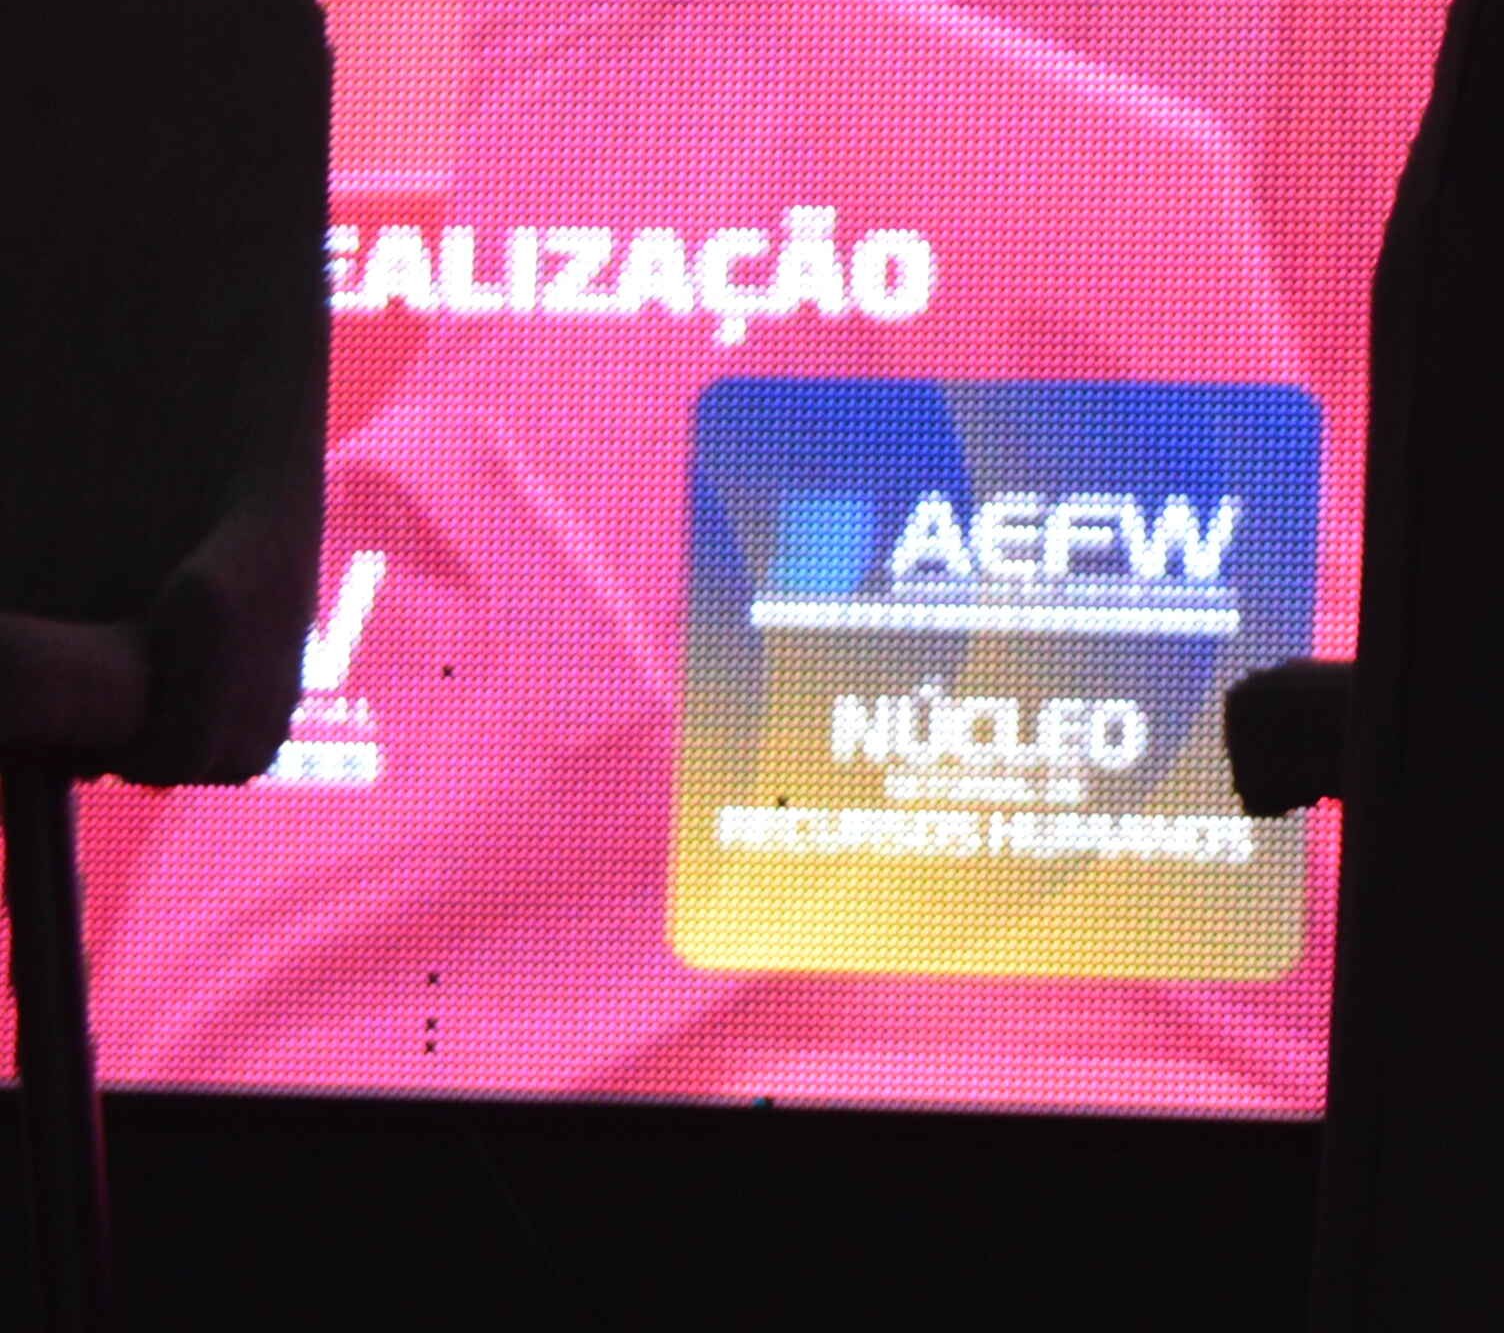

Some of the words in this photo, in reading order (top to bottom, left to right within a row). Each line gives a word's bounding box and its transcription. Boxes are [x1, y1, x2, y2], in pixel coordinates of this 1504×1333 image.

[324, 205, 938, 348] EALIZAÇÃO
[891, 489, 1242, 579] AEFW
[830, 673, 1149, 771] NÚCLEO
